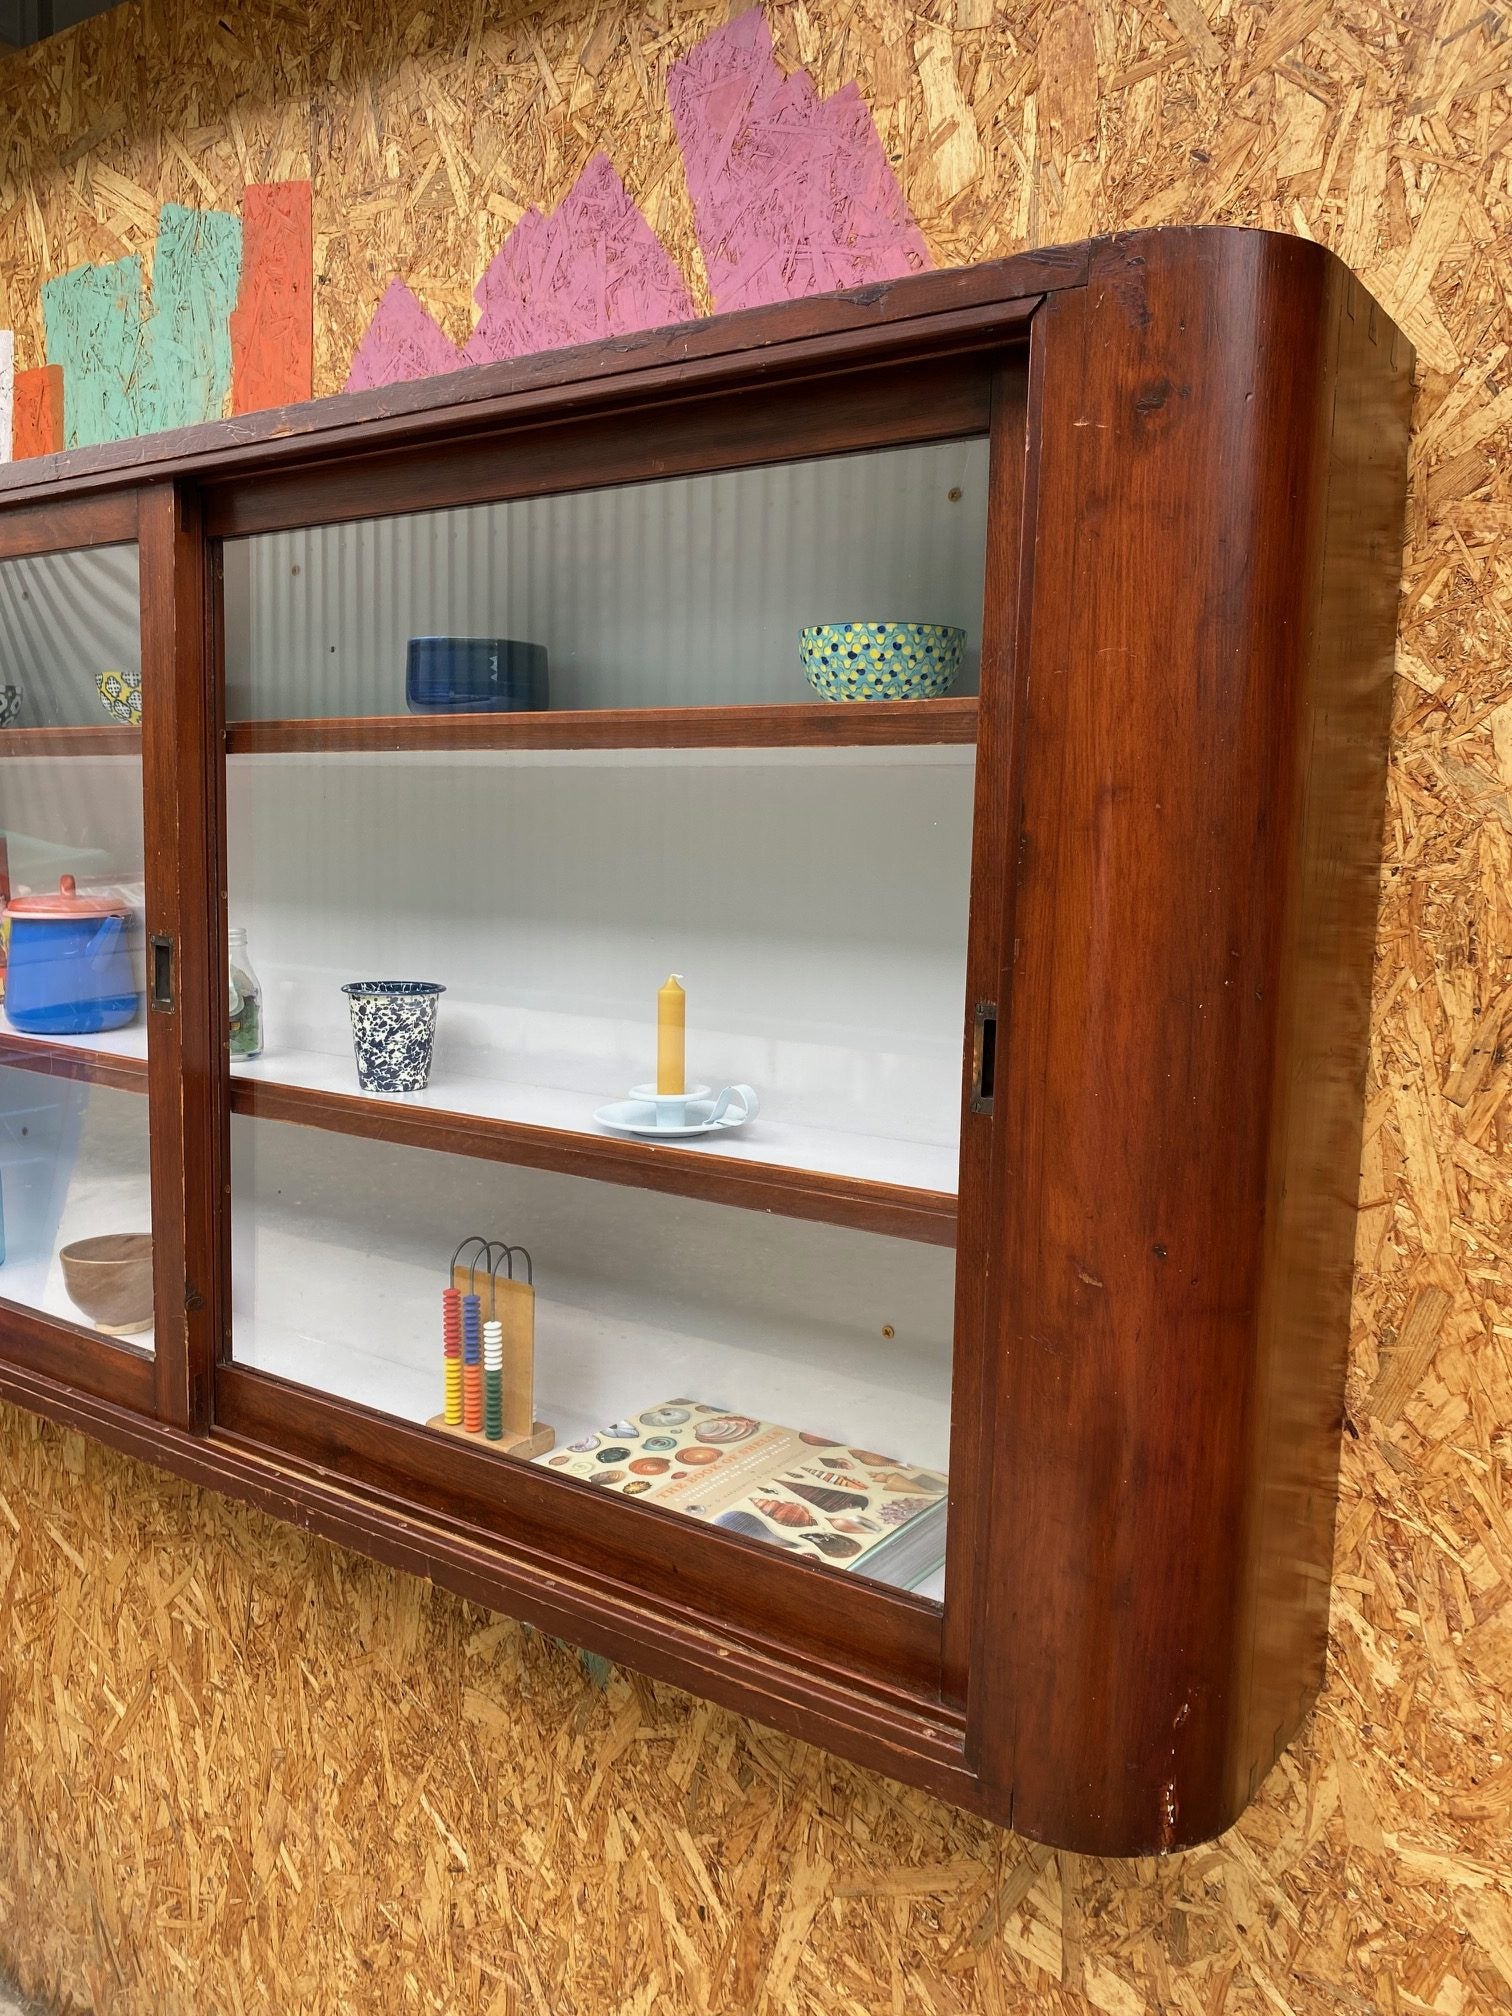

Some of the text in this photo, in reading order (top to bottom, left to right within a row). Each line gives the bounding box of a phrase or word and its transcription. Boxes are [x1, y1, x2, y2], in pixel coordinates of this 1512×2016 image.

[657, 1483, 686, 1499] THE
[688, 1462, 721, 1483] BOOK
[722, 1453, 737, 1464] OF
